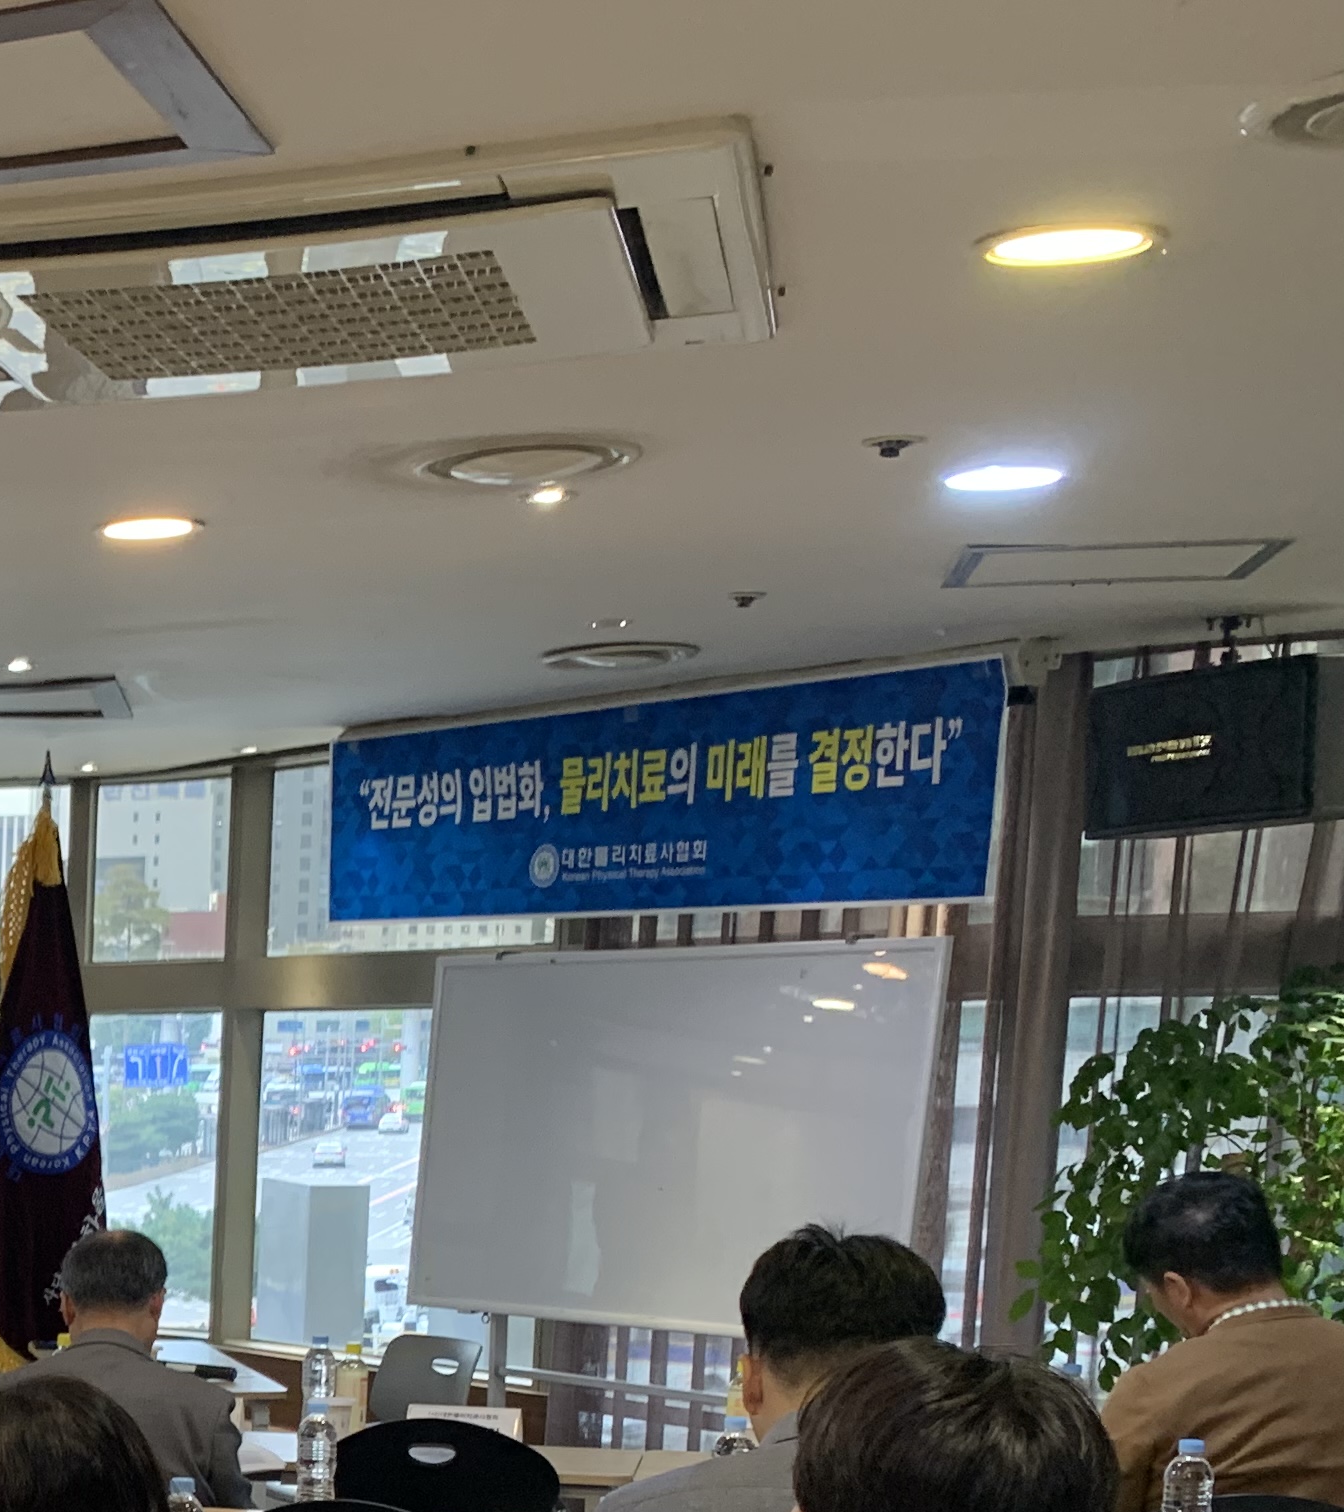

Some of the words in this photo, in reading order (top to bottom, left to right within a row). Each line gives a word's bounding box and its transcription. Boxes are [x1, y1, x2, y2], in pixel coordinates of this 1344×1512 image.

[359, 768, 461, 830] “전문성의
[469, 758, 550, 824] 입법화,
[559, 742, 699, 816] 물리치료의
[706, 733, 799, 802] 미래를
[808, 716, 963, 794] 결정한다”
[562, 839, 708, 870] 대한물리치료사협회
